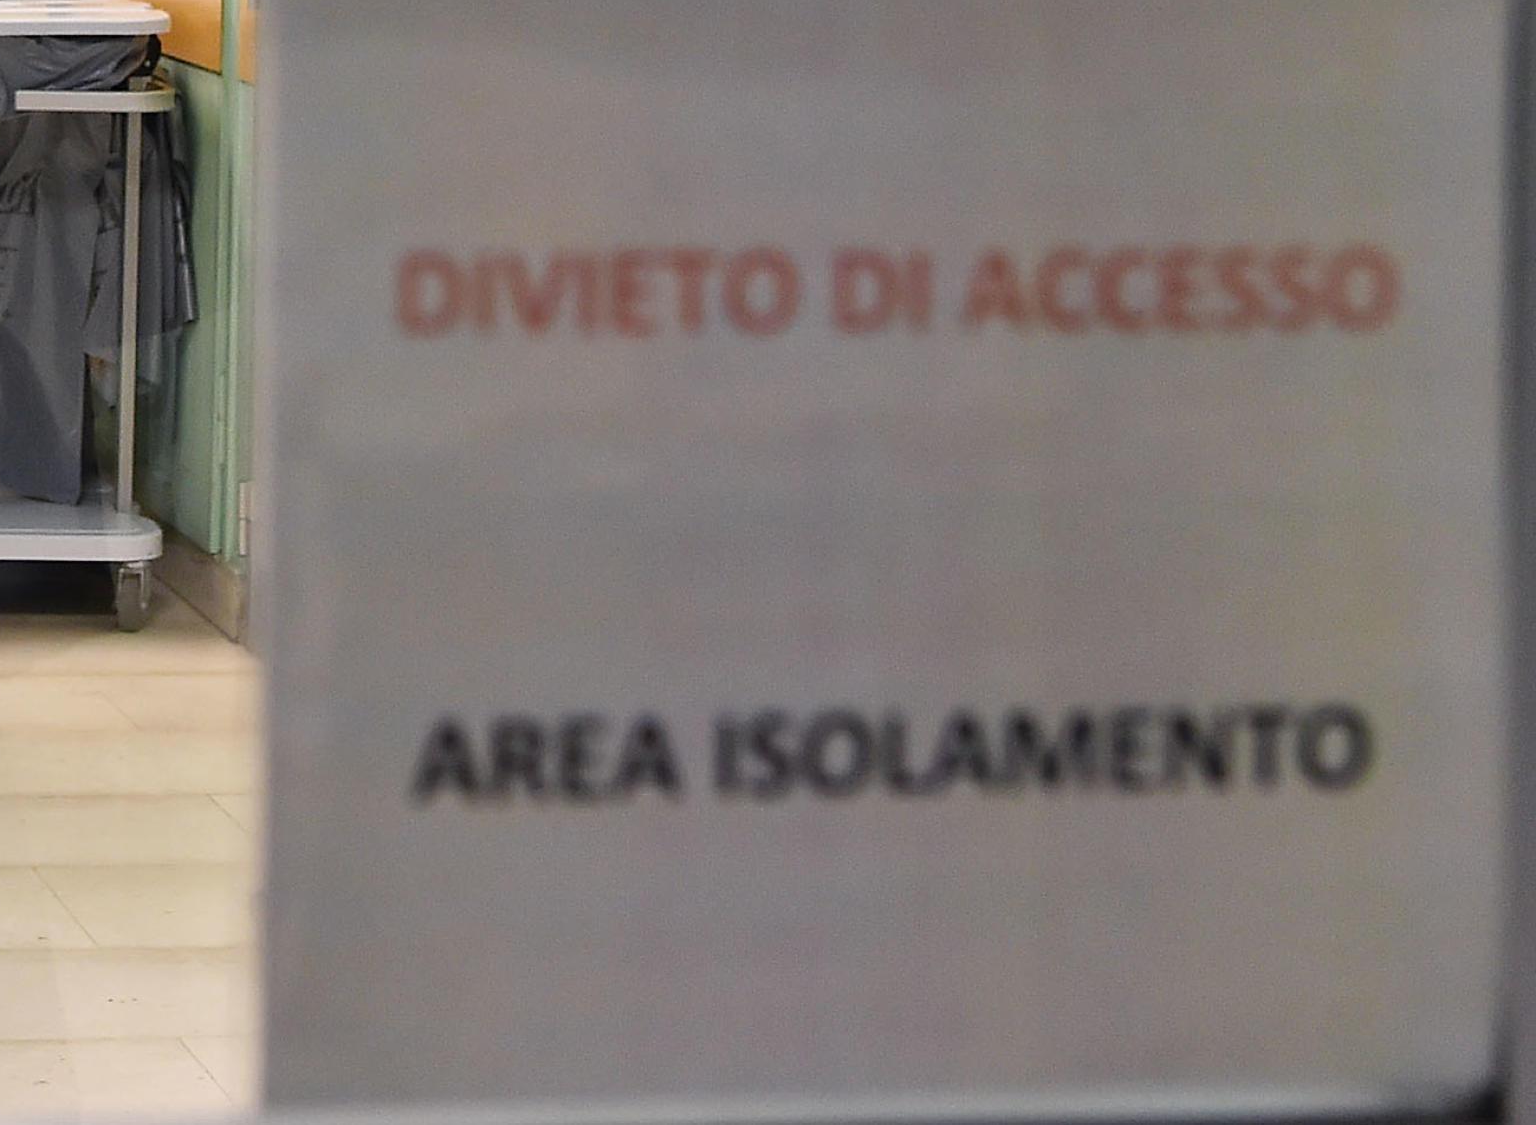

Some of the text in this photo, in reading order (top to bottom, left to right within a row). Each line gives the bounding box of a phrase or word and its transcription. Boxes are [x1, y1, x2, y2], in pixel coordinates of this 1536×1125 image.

[396, 242, 1402, 338] DIVIETO DI ACCESSO
[408, 702, 1378, 805] AREA ISOLAMENTO
